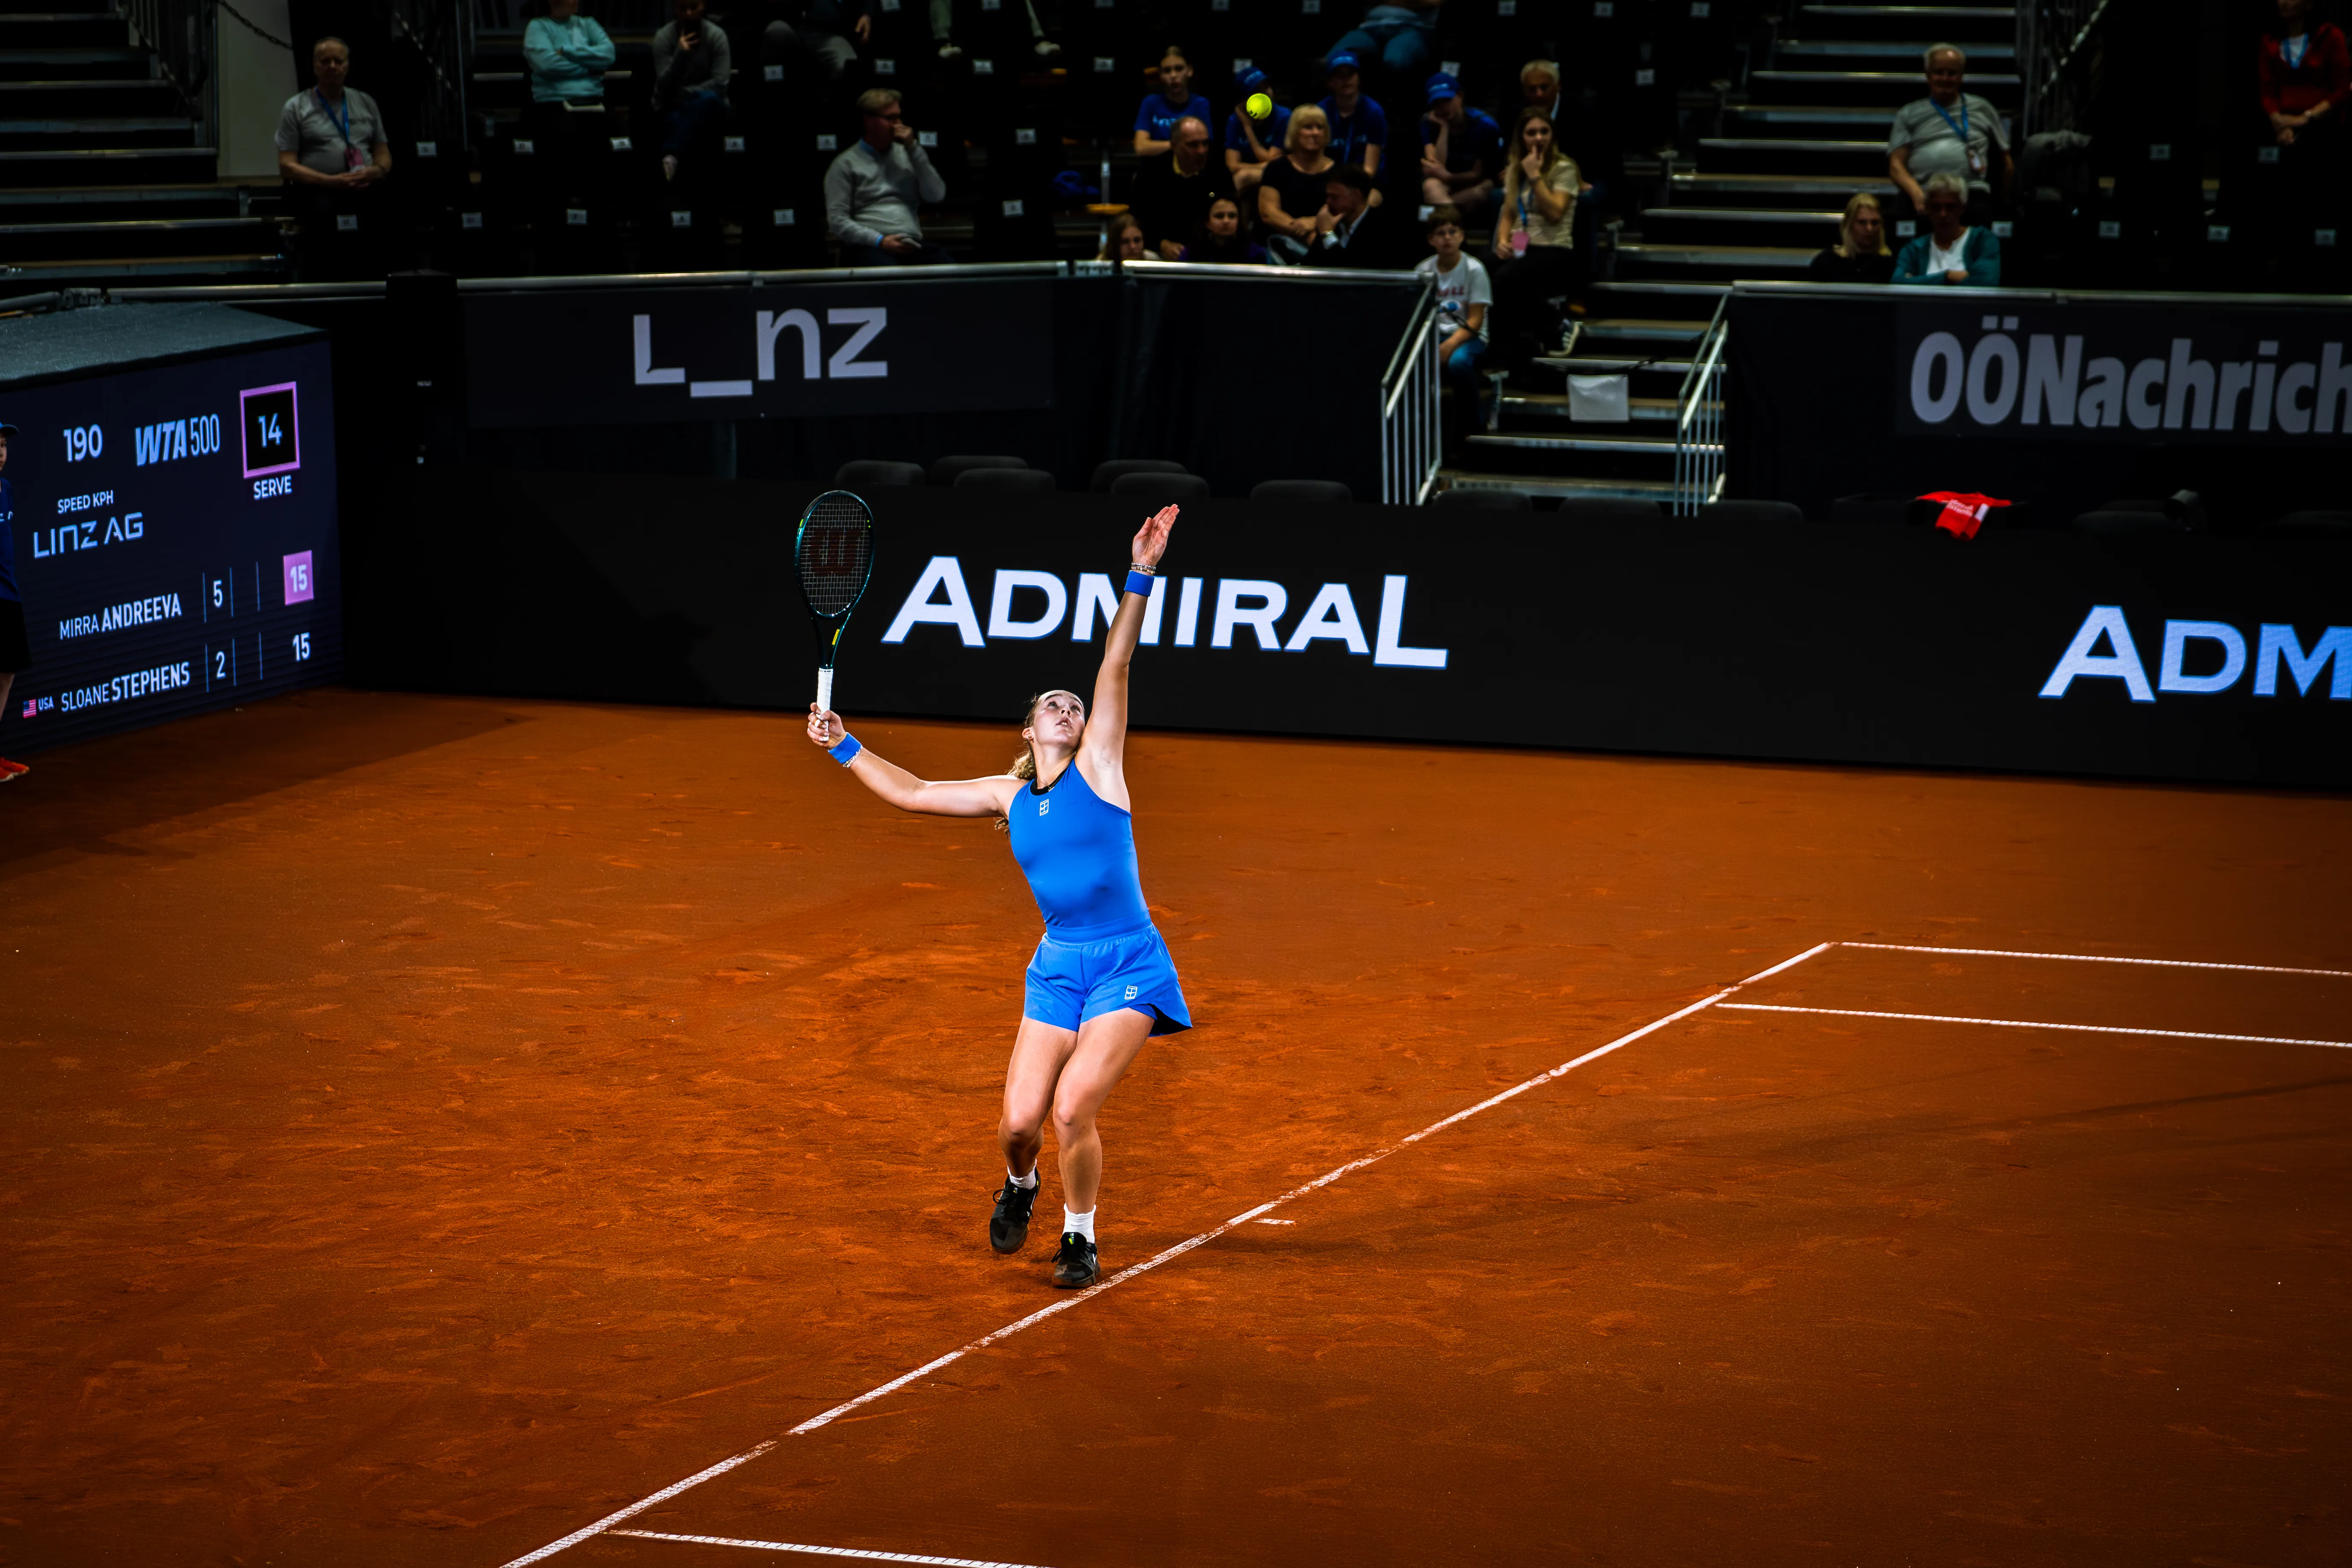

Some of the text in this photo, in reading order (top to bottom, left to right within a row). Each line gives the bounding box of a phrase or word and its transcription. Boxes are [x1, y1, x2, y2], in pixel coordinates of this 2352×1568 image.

[1910, 315, 2352, 435] OÖNachrich
[63, 424, 103, 463] 190
[135, 413, 221, 467] WTA 500
[258, 413, 283, 448] 14
[57, 490, 114, 514] SPEED KPH
[254, 475, 293, 500] SERVE
[33, 512, 144, 558] LINZ AG
[213, 579, 224, 608] 5
[290, 564, 307, 592] 15
[59, 593, 183, 640] MIRRA ANDREEVA
[881, 555, 1449, 670] ADMIRAL
[215, 651, 227, 679] 2
[292, 632, 311, 662] 15
[2038, 604, 2352, 703] ADM
[38, 661, 191, 712] USA SLOANE STEPHENS
